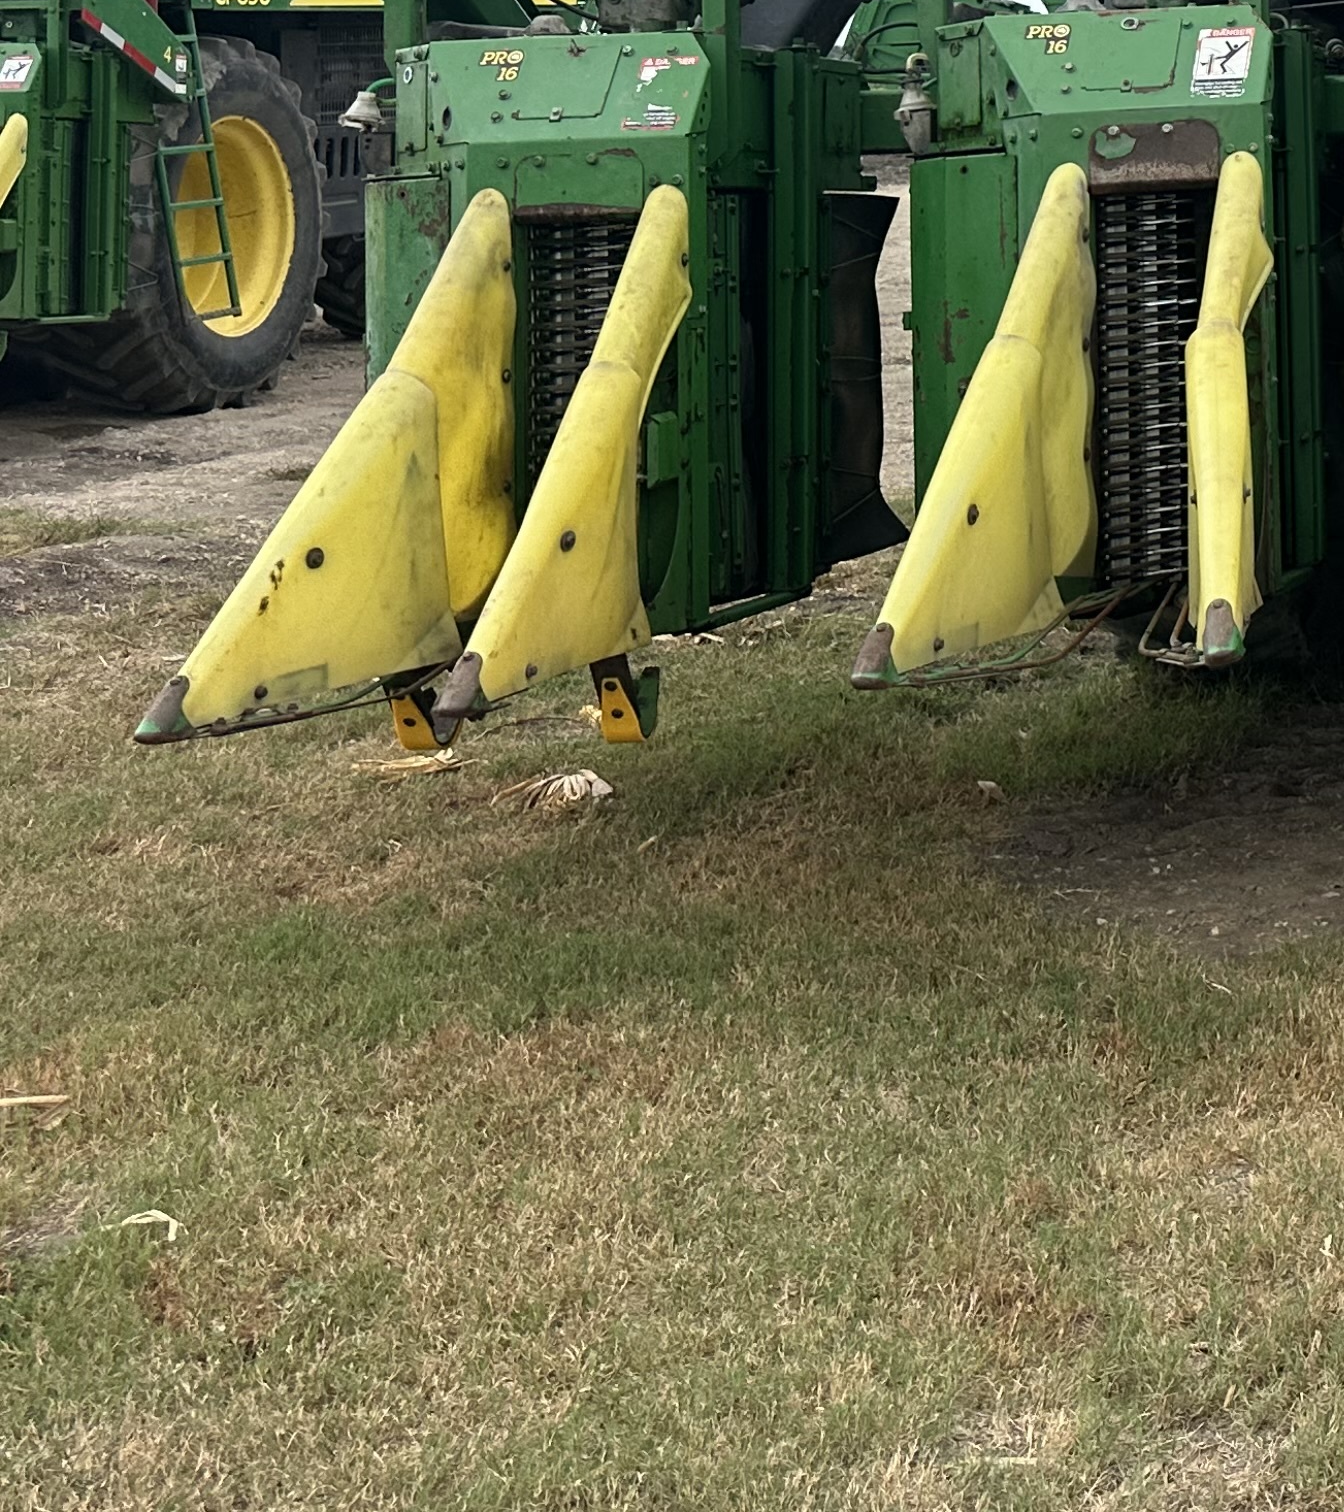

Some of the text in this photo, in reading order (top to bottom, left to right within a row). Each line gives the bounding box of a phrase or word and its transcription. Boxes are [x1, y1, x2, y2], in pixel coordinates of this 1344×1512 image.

[1026, 24, 1071, 39] PRO
[1047, 39, 1068, 54] 16
[163, 45, 172, 64] 4
[480, 50, 524, 65] PRO
[655, 57, 696, 66] DAER
[497, 66, 519, 81] 16
